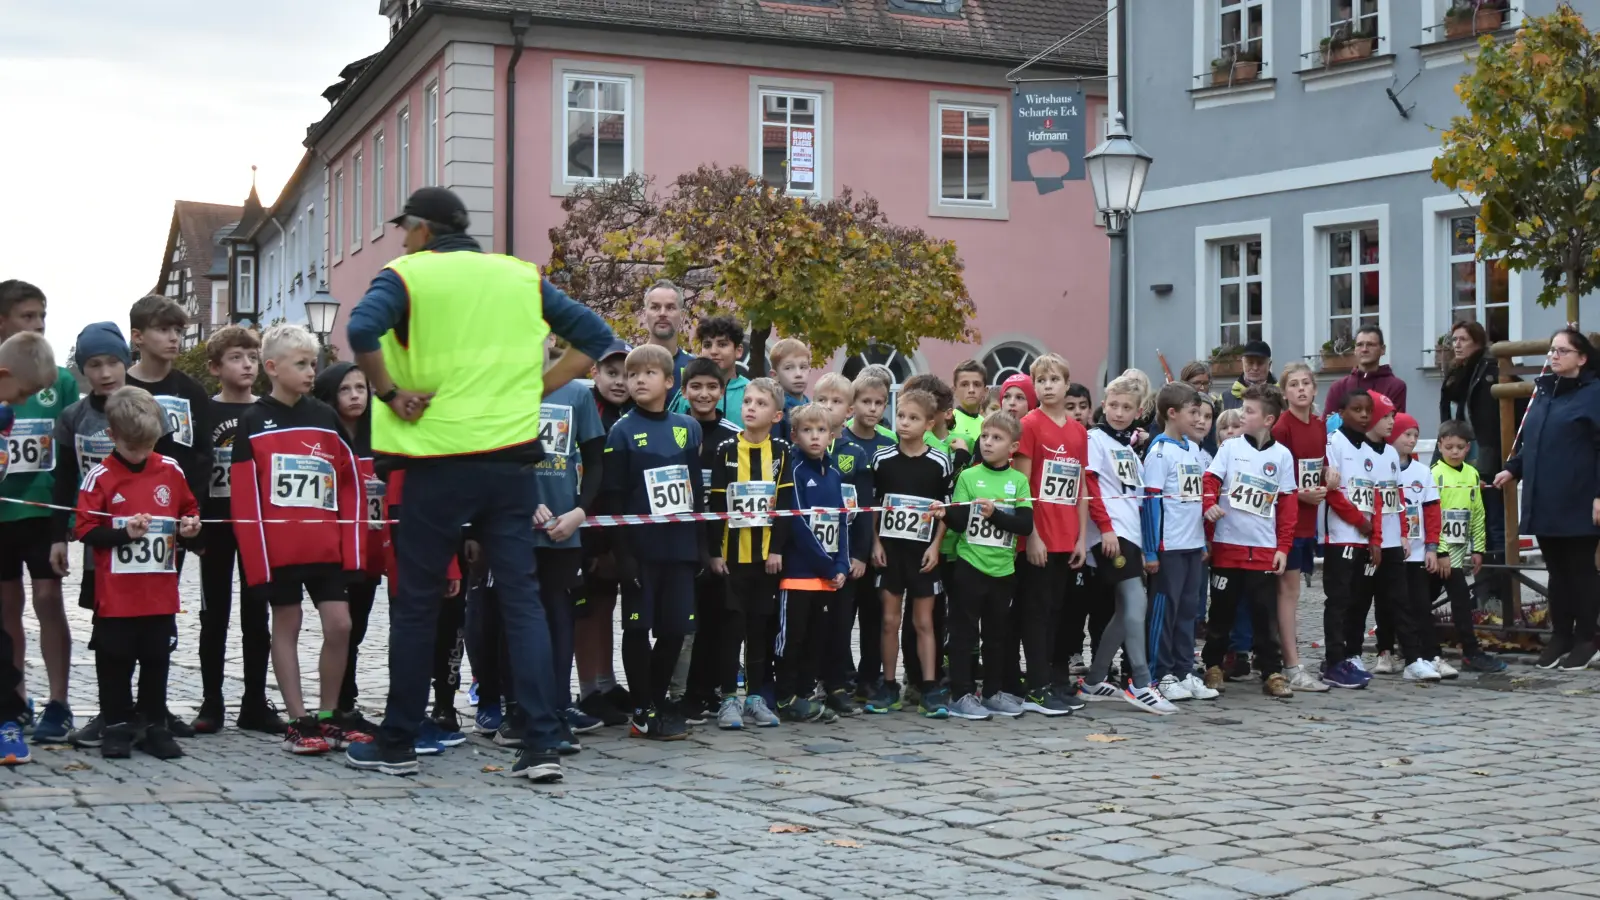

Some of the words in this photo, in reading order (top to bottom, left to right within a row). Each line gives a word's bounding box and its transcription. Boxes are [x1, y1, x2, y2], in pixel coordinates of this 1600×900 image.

[1025, 93, 1073, 104] Wirtshaus
[1018, 106, 1059, 118] Scharfes
[1060, 105, 1078, 117] Eck
[1028, 130, 1068, 141] Hofmann
[276, 473, 321, 499] 571
[652, 482, 687, 508] 507
[1044, 475, 1076, 499] 578
[1231, 485, 1264, 509] 410
[732, 497, 768, 521] 516
[1352, 488, 1375, 508] 419
[884, 510, 920, 533] 682
[117, 536, 165, 564] 630
[629, 612, 639, 621] JS
